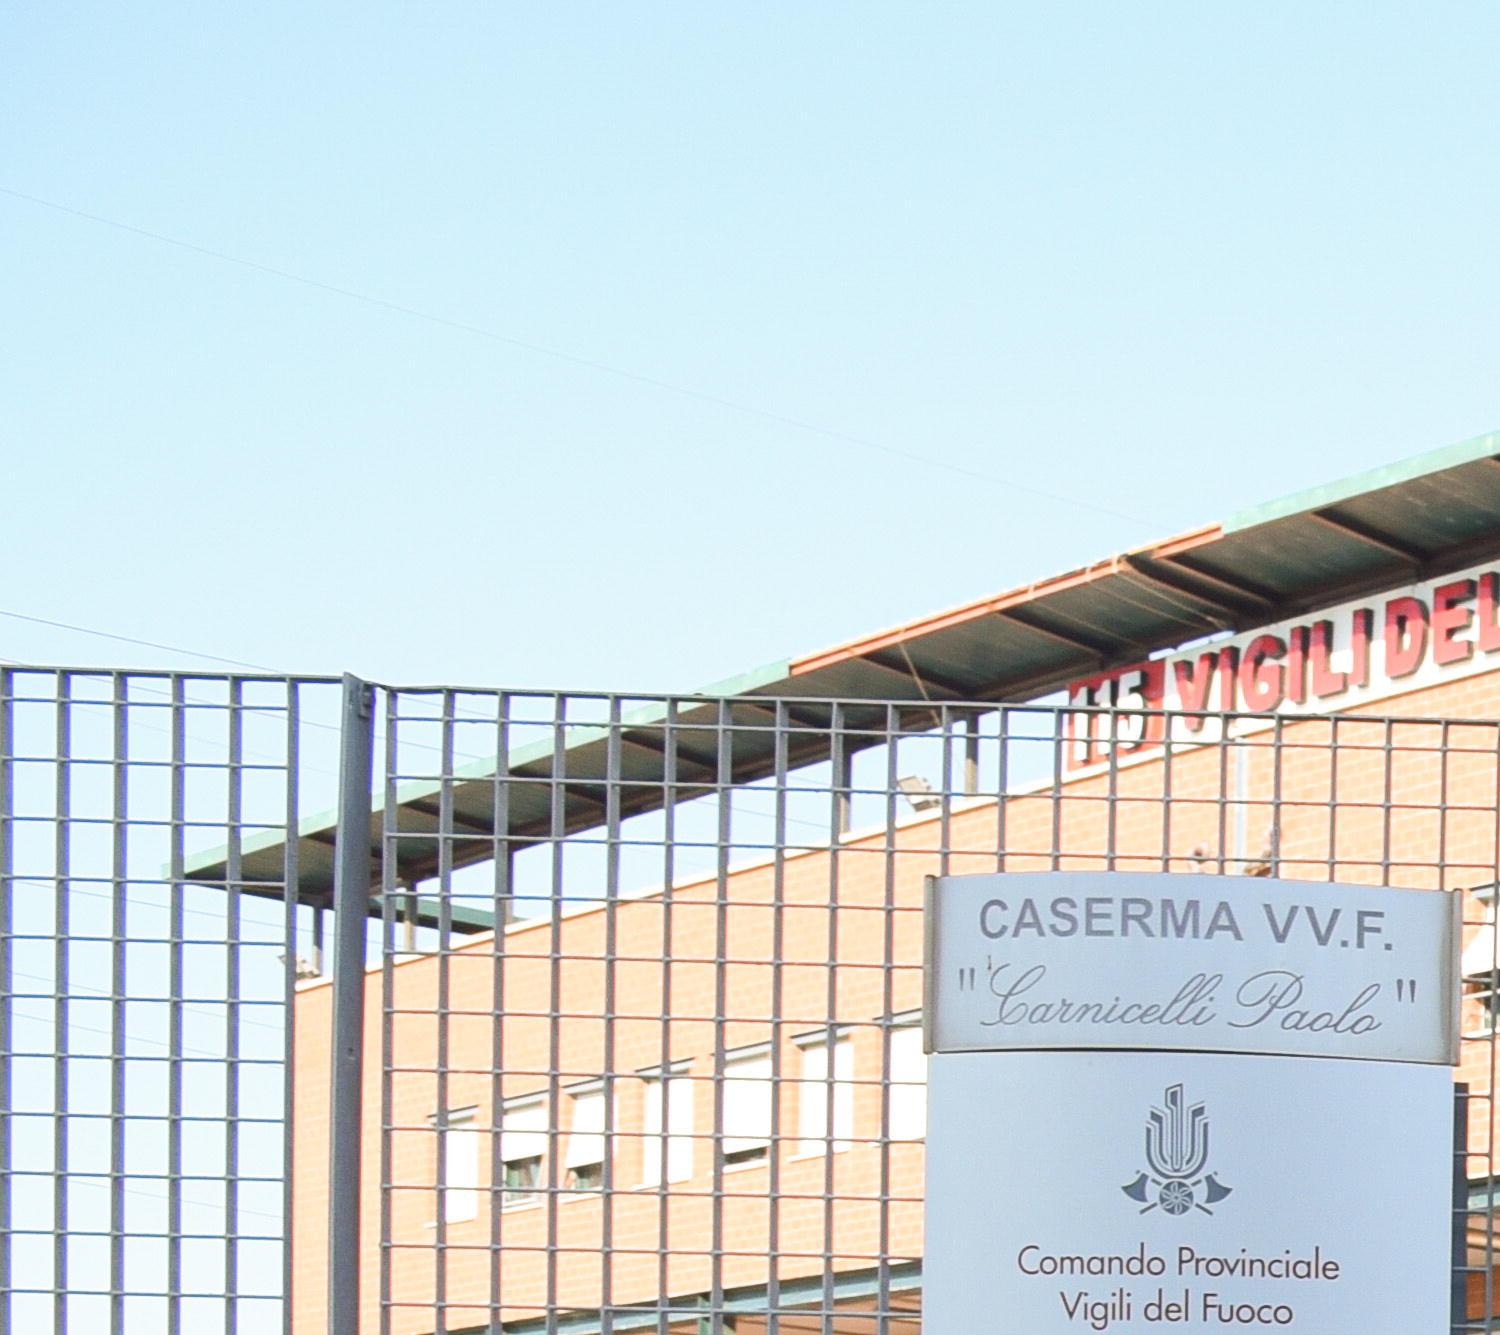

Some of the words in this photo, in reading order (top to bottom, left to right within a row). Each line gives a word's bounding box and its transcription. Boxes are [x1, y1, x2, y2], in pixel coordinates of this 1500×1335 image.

[1173, 608, 1374, 732] VIGILI
[979, 896, 1243, 942] CASERMA
[1262, 902, 1393, 951] VV.F.
[1018, 1242, 1166, 1277] Comando
[1178, 1246, 1340, 1280] Provinciale
[1059, 1288, 1132, 1331] Vigili
[1144, 1288, 1190, 1322] del
[1202, 1293, 1294, 1325] Fuoco
